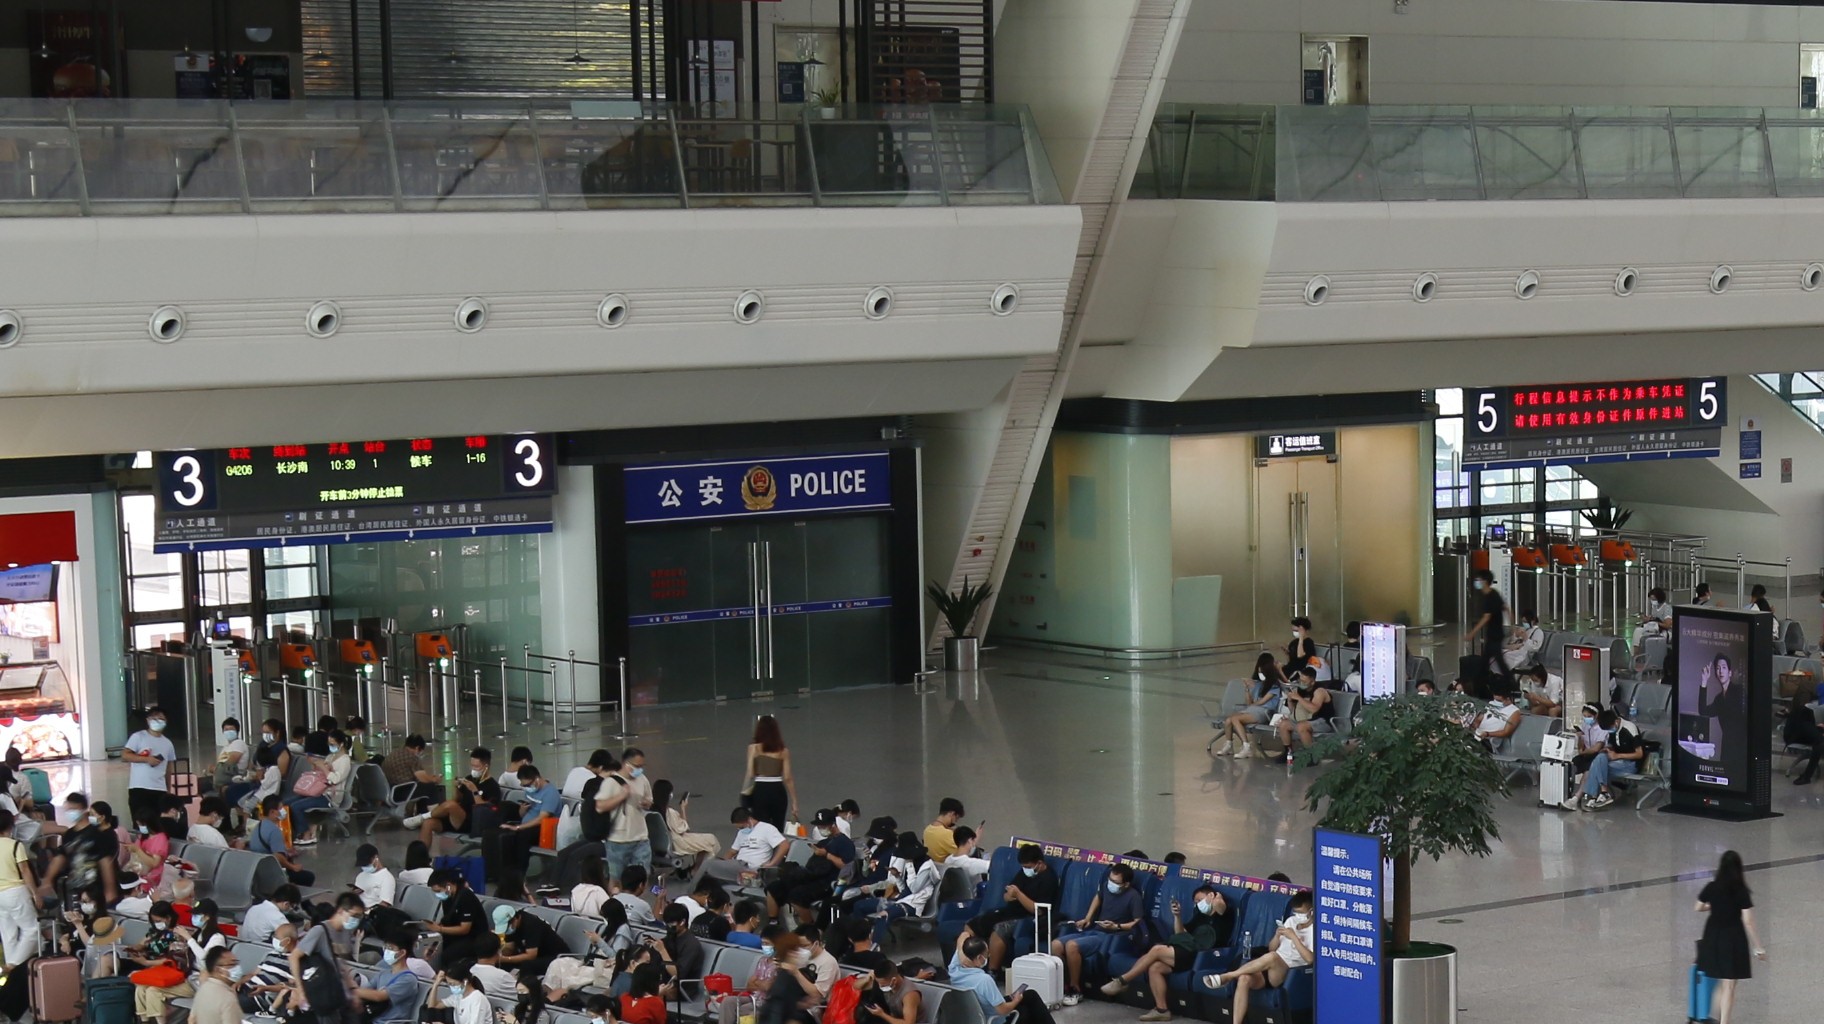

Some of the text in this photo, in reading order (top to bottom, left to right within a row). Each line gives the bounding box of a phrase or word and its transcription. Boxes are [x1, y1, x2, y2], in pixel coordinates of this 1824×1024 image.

[1514, 384, 1685, 406] 行程信息提示不作为乘车凭证
[1700, 381, 1718, 421] 5
[1477, 392, 1498, 433] 5
[1514, 405, 1686, 428] 请使用有效身份证件原件进站
[276, 461, 308, 475] 长沙南
[330, 459, 356, 470] 10:39
[373, 458, 378, 469] 1
[410, 455, 432, 468] 候车
[466, 453, 486, 464] 1-16
[514, 439, 543, 487] 3
[173, 454, 204, 506] 3
[320, 486, 404, 502] 开车前3分钟停止检票
[658, 476, 723, 507] 公安
[790, 469, 866, 497] POLICE
[176, 518, 216, 527] 人工通道
